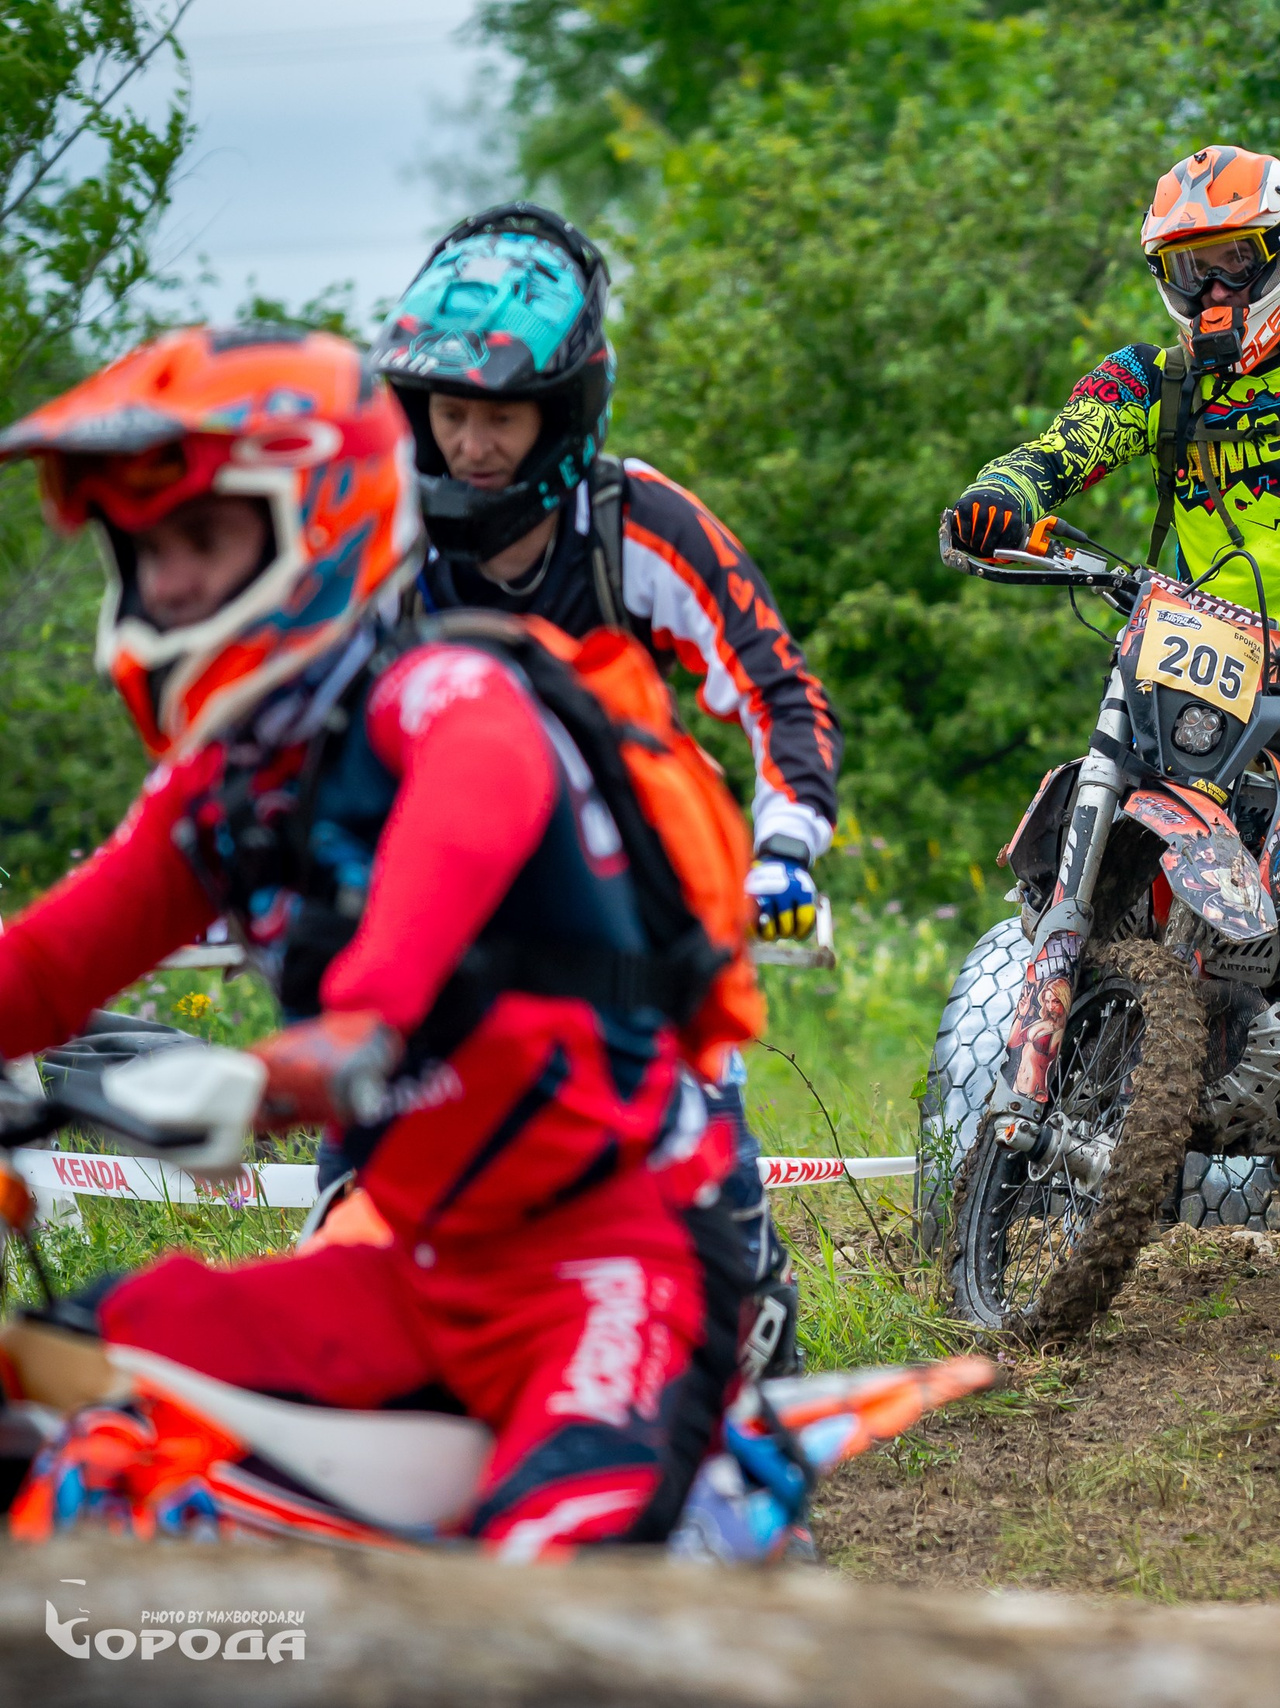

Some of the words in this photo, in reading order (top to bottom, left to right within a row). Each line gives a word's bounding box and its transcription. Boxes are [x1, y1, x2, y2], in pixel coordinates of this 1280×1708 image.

[1097, 360, 1146, 398] RACING
[1234, 632, 1261, 653] БРОНЗА
[1158, 635, 1246, 700] 205
[52, 1157, 130, 1191] KENDA
